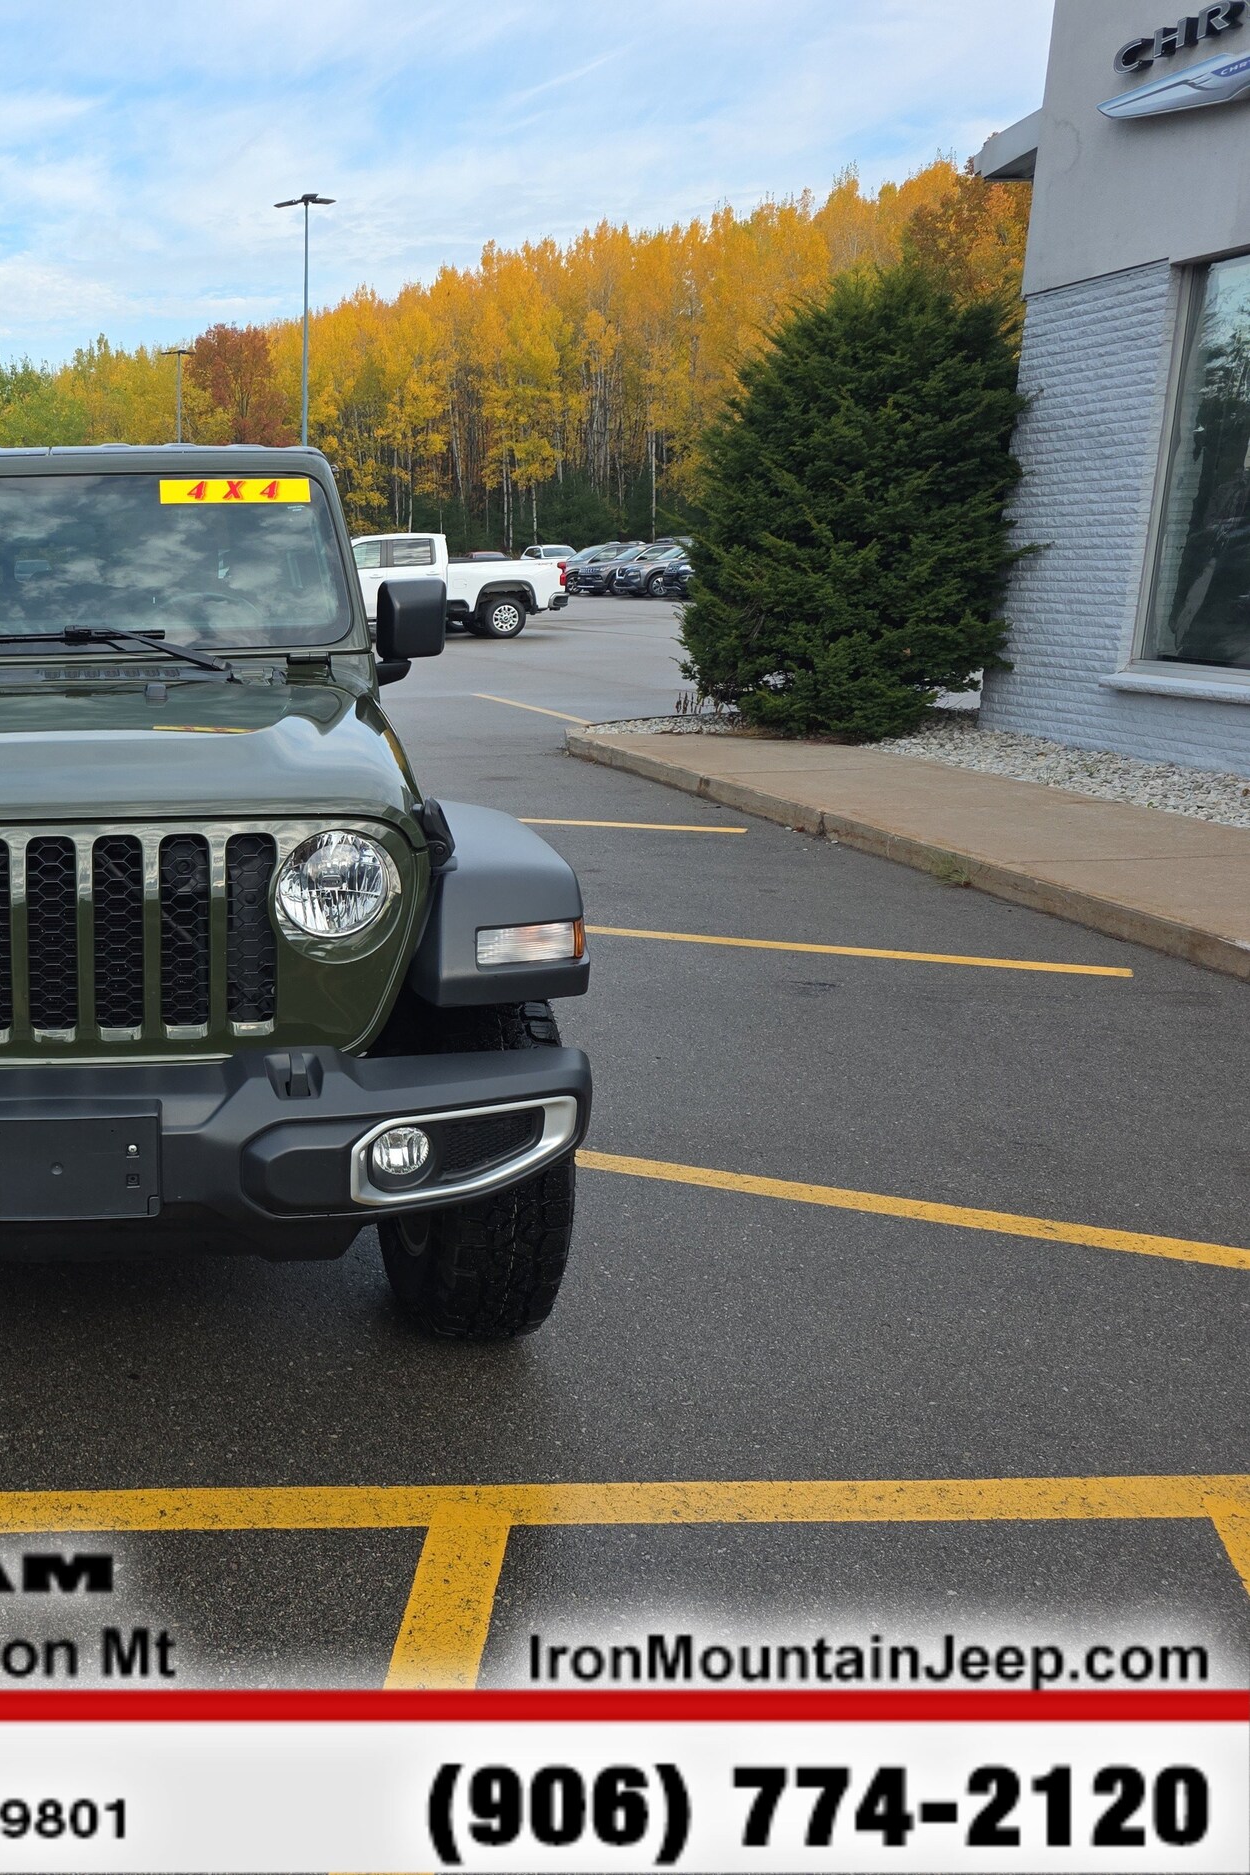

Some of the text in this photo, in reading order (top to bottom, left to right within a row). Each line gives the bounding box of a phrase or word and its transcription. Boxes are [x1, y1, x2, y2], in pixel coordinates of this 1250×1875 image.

[1113, 0, 1250, 74] CHR
[1219, 59, 1250, 76] CHR
[186, 480, 207, 500] 4
[259, 480, 279, 500] 4
